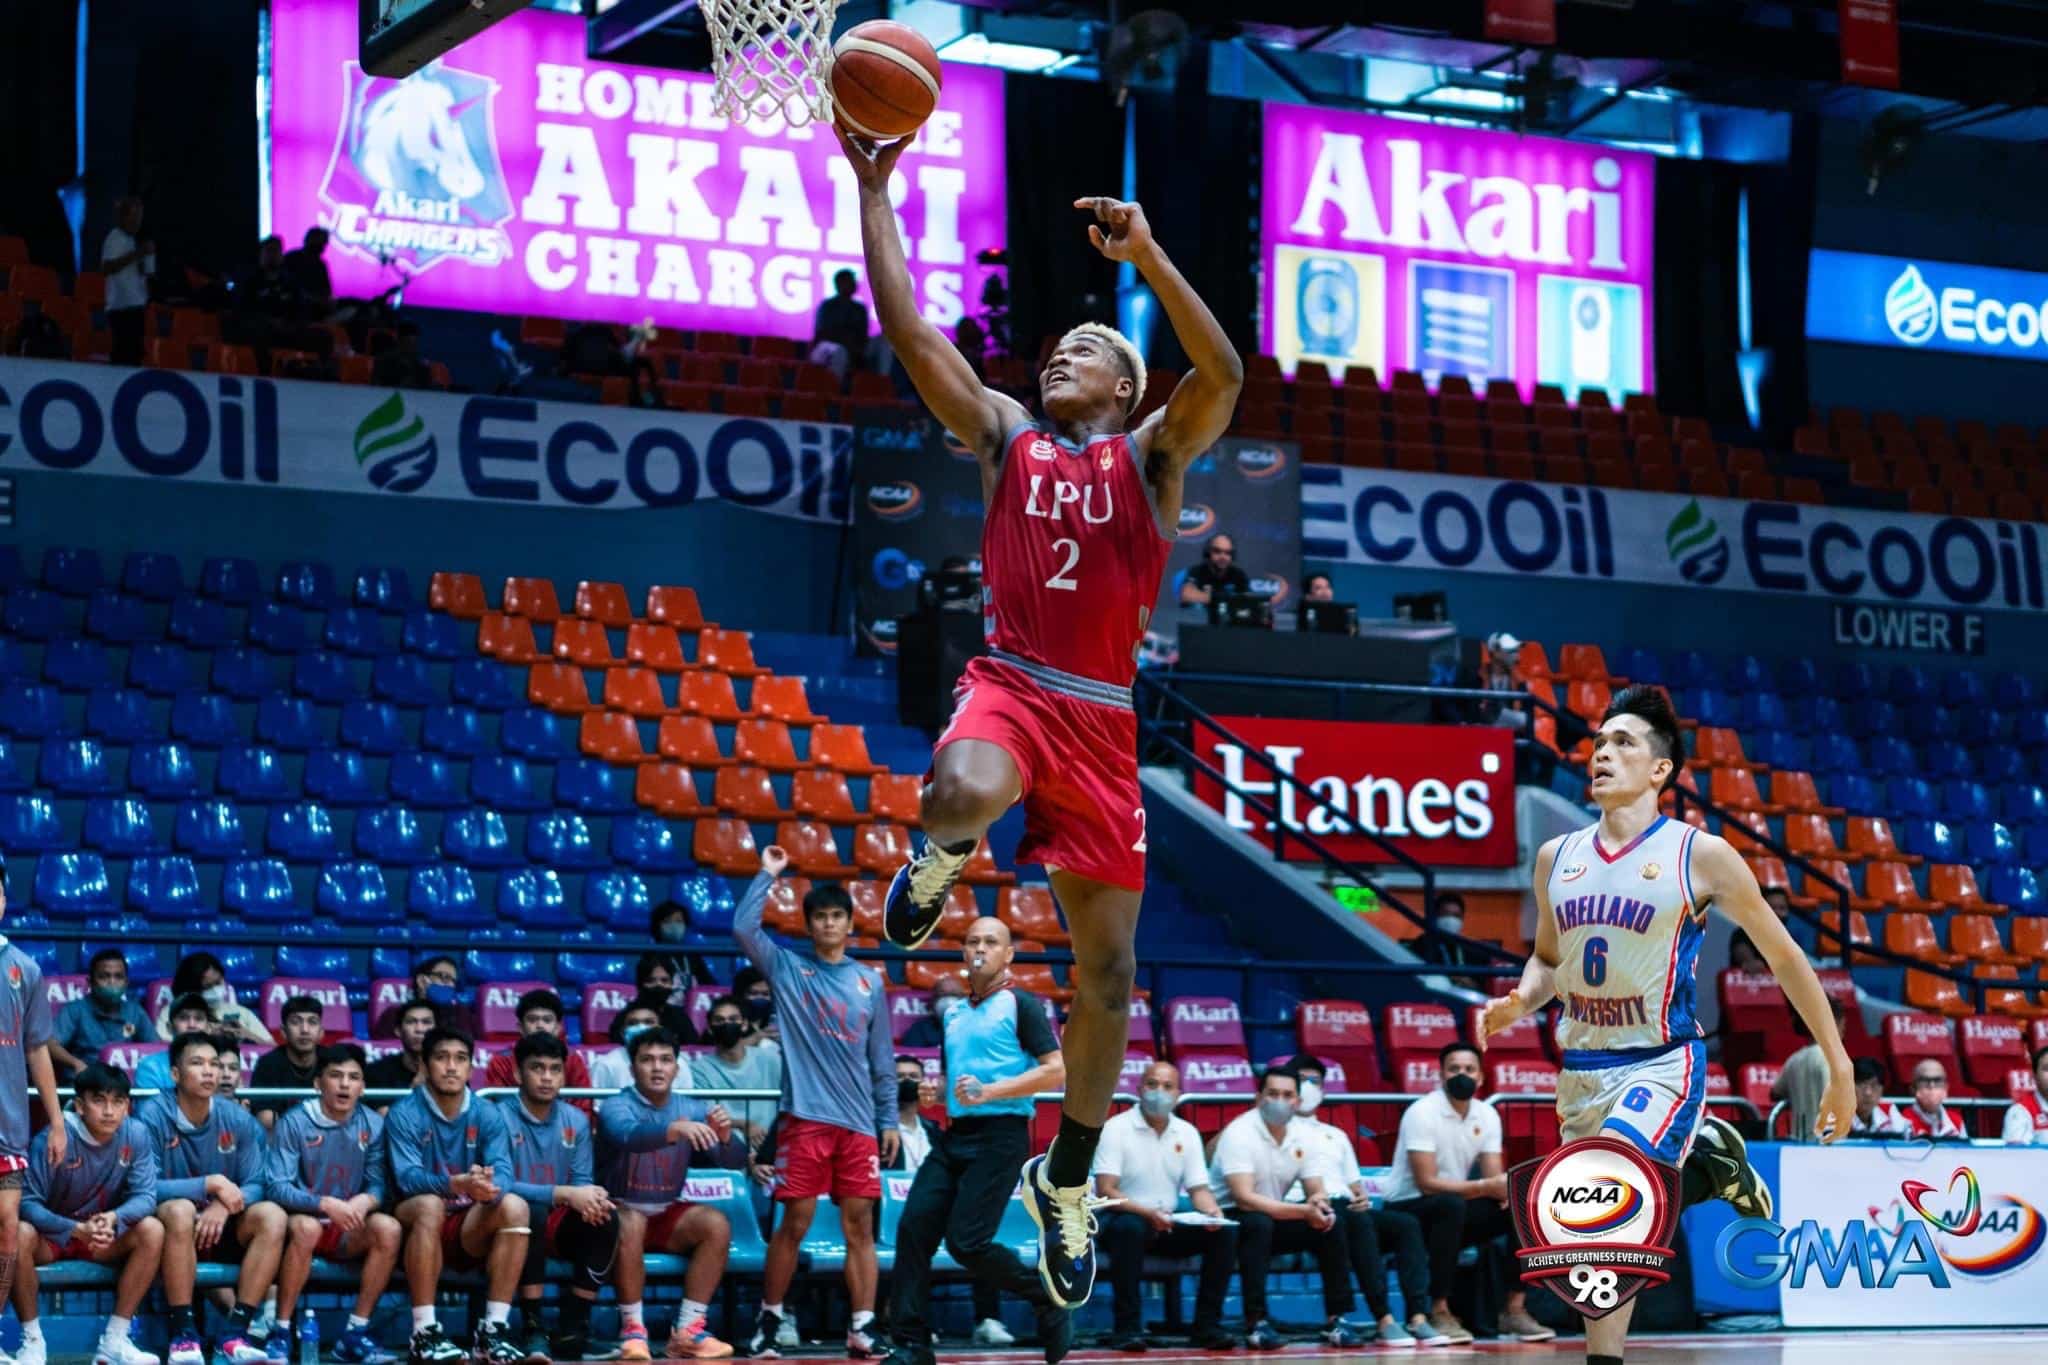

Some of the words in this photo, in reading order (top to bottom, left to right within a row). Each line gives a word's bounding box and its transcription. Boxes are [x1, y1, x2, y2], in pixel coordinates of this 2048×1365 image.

[536, 63, 729, 132] HOME
[373, 190, 460, 222] Akari
[522, 123, 966, 265] AKARI
[1291, 131, 1626, 272] Akari
[1940, 287, 2048, 348] Eco
[0, 369, 280, 483] oOil
[458, 395, 852, 524] EcoOil
[869, 486, 912, 499] NCAA
[1025, 474, 1114, 525] LPU
[1179, 508, 1208, 522] CAA
[1302, 466, 1614, 577] EcoOil
[1045, 538, 1080, 591] 2
[1742, 501, 2045, 609] EcoOil
[1250, 578, 1281, 593] CAA
[1834, 606, 1951, 649] LOWER
[1964, 615, 1982, 651] F
[1214, 743, 1494, 840] Hanes
[1555, 893, 1656, 936] ARELLANO
[1582, 936, 1609, 988] 6
[1174, 1002, 1240, 1022] Akari
[1304, 1004, 1370, 1026] Hanes
[1392, 1007, 1456, 1028] Hanes
[1892, 1017, 1949, 1039] Hanes
[1964, 1020, 2021, 1041] Hanes
[1184, 1060, 1253, 1080] Akari
[1496, 1064, 1558, 1085] Hanes
[1621, 1086, 1653, 1113] 6
[682, 1178, 731, 1200] Akari
[1938, 1210, 2019, 1233] NAA
